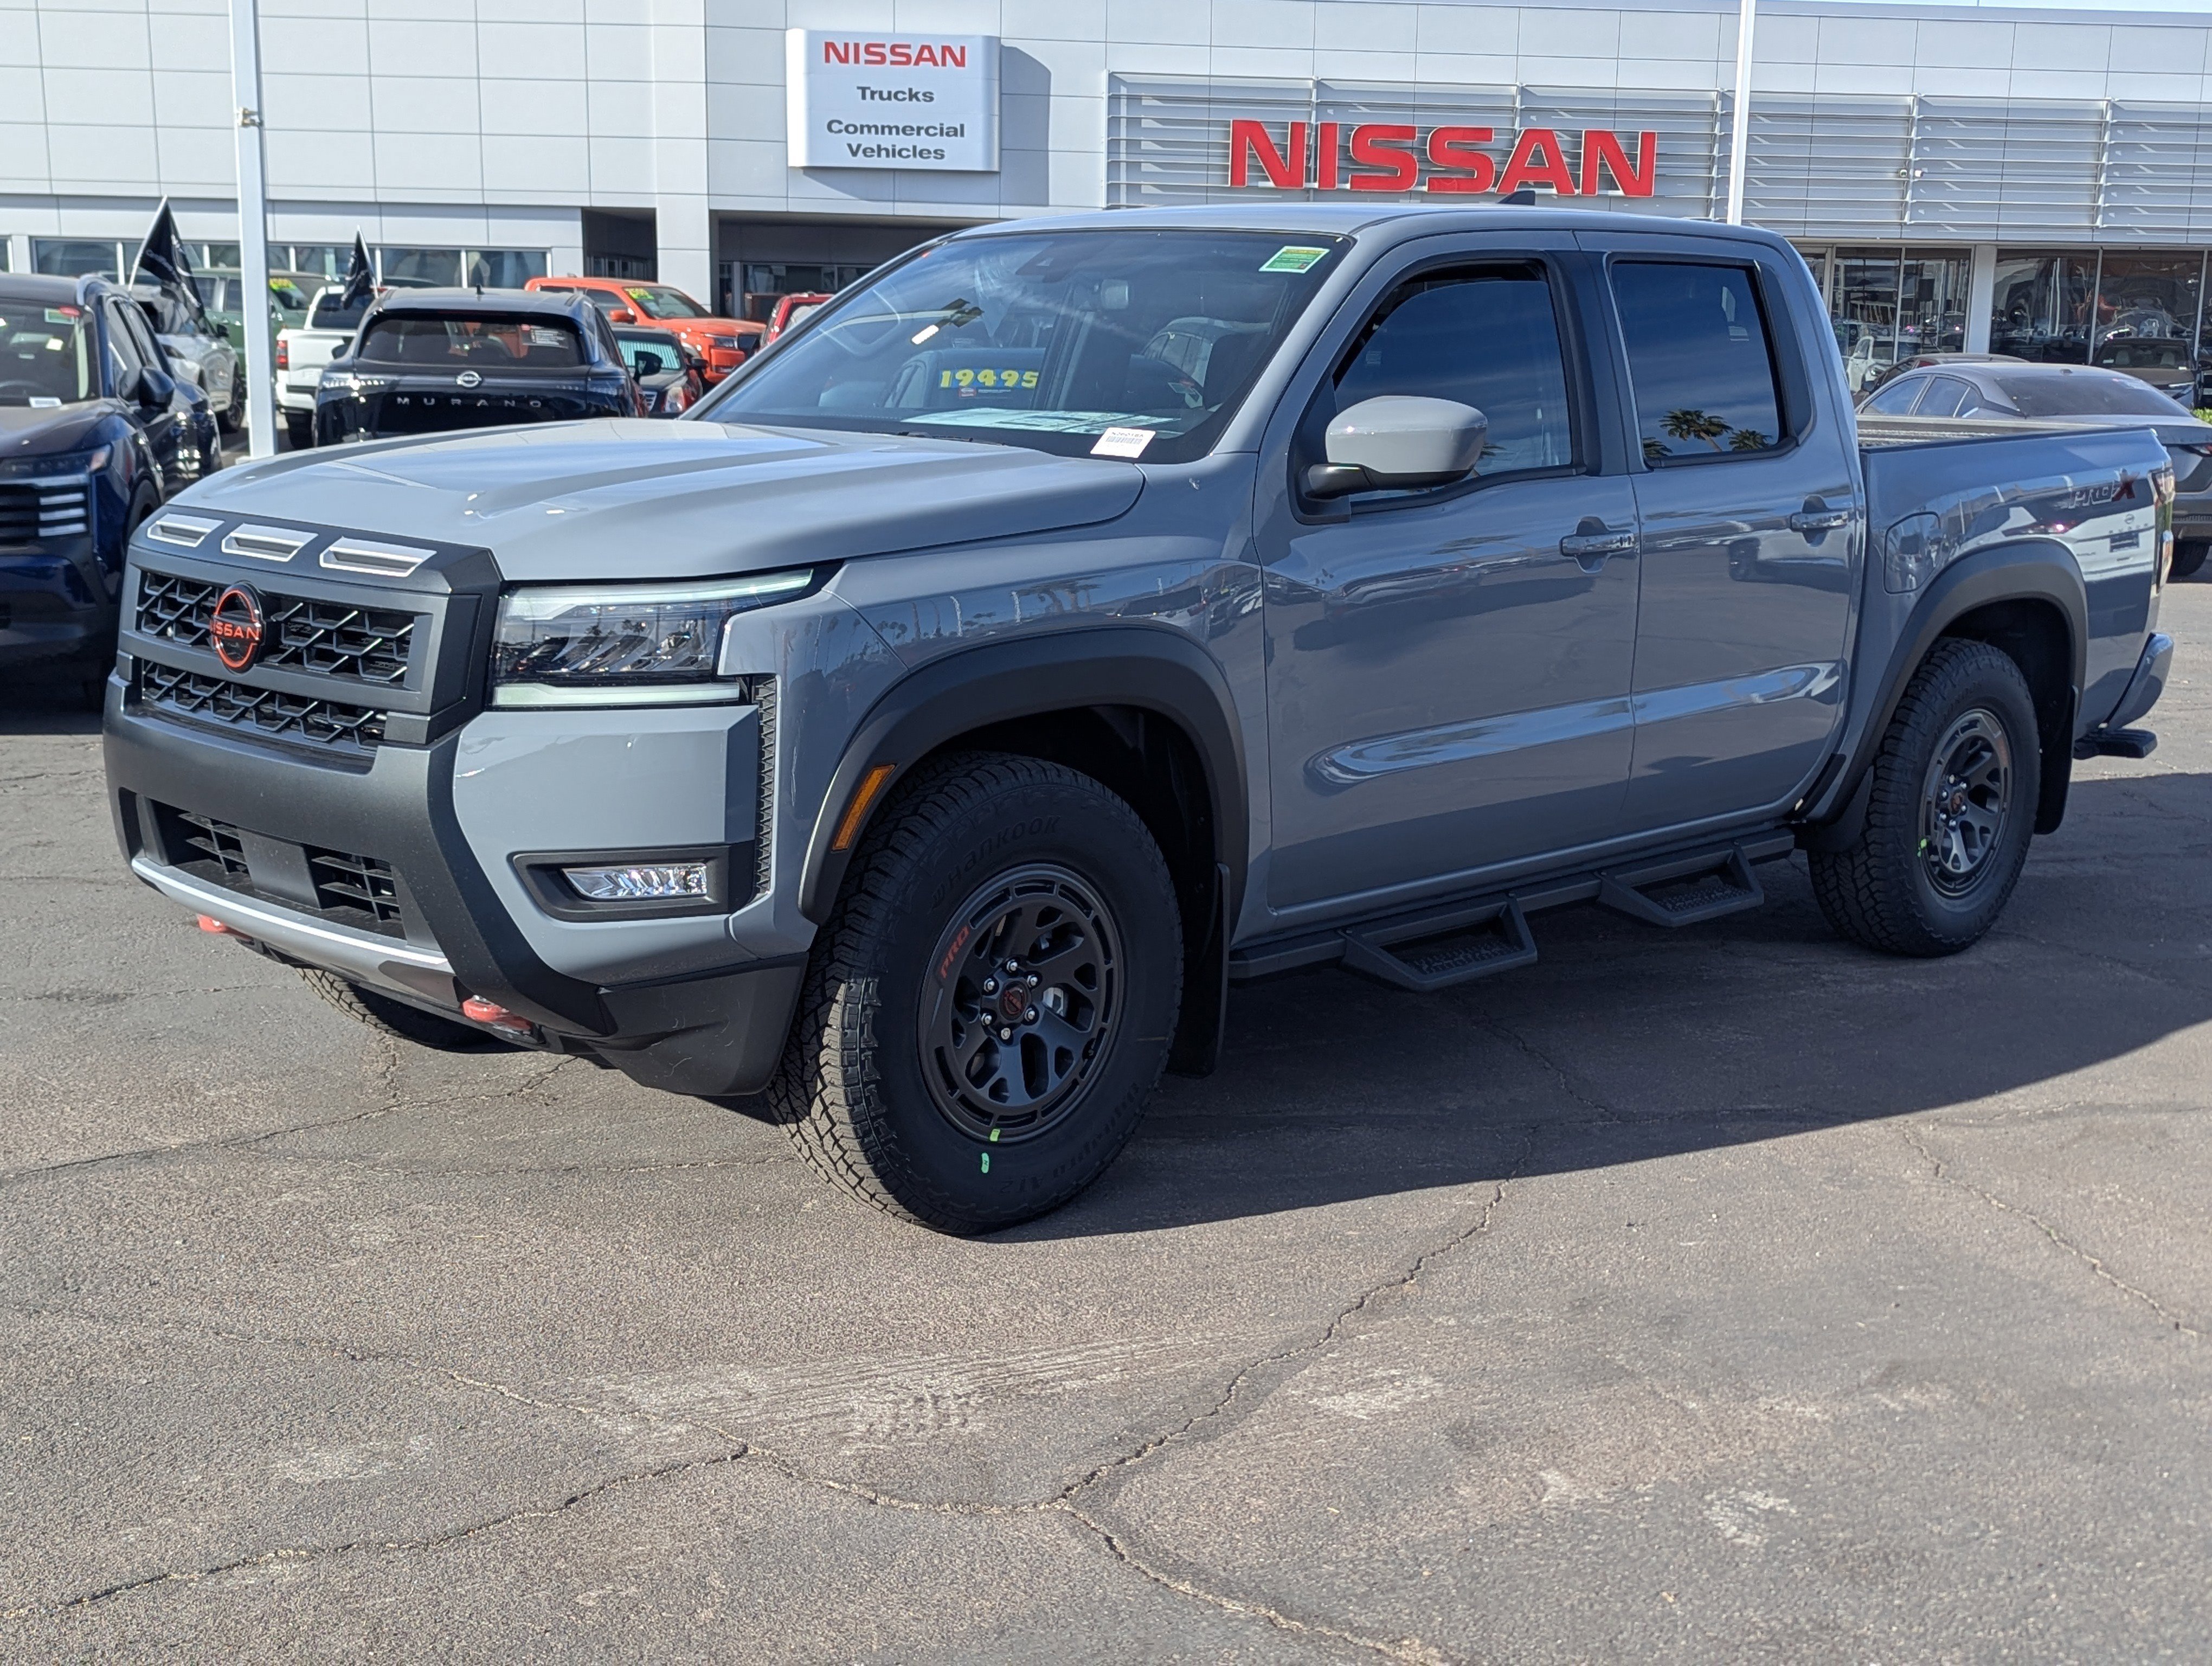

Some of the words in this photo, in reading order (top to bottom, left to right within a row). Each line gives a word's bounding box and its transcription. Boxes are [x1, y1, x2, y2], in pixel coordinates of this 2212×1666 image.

[824, 41, 966, 68] NISSAN
[856, 85, 935, 103] Trucks
[826, 119, 965, 138] Commercial
[847, 143, 946, 161] Vehicles
[1229, 119, 1658, 197] NISSAN
[940, 369, 1039, 389] 19495
[396, 396, 543, 408] MURANO
[209, 620, 260, 640] NISSAN
[940, 926, 969, 979] PRO
